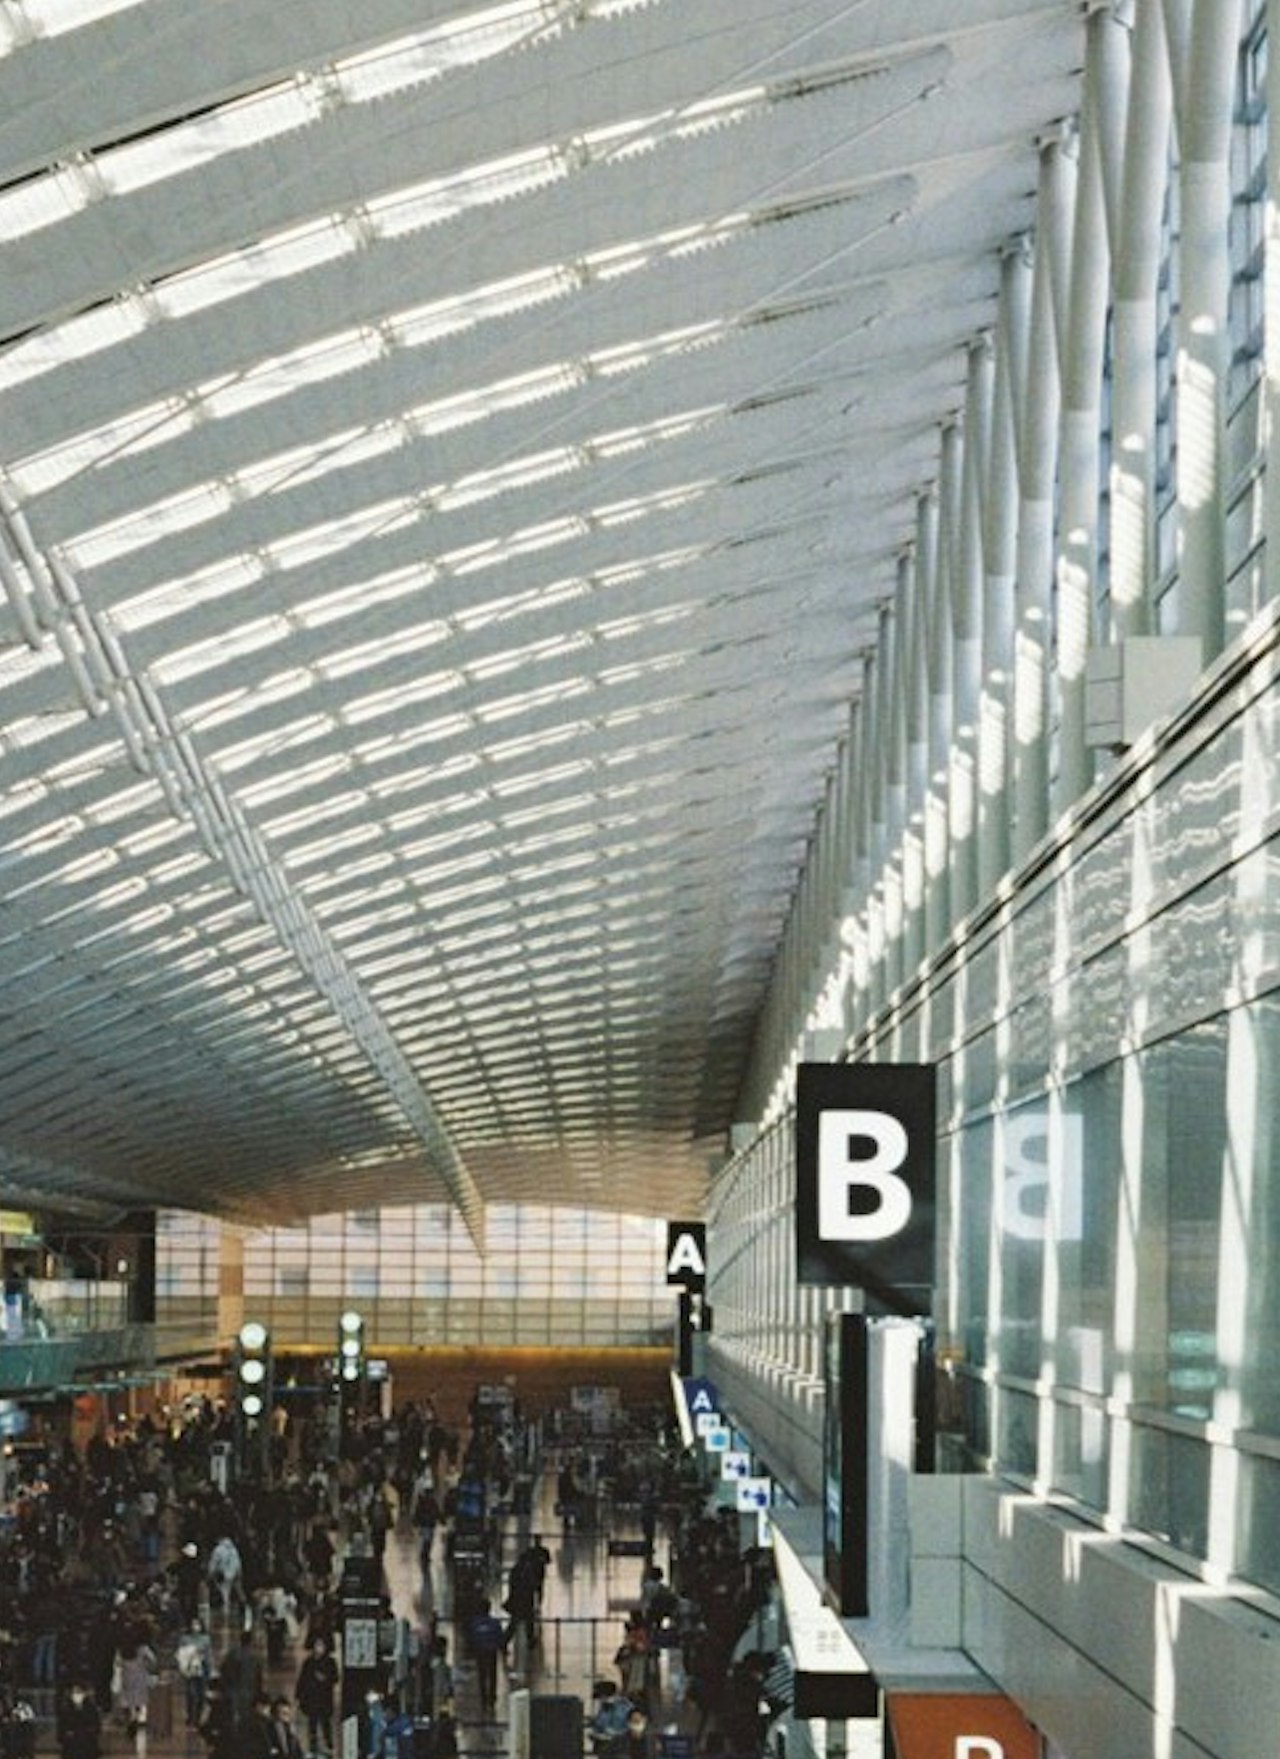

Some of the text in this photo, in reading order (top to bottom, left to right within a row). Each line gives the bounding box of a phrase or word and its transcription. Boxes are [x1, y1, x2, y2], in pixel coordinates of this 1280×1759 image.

[819, 1110, 912, 1240] B
[669, 1233, 705, 1275] A
[692, 1389, 713, 1411] A
